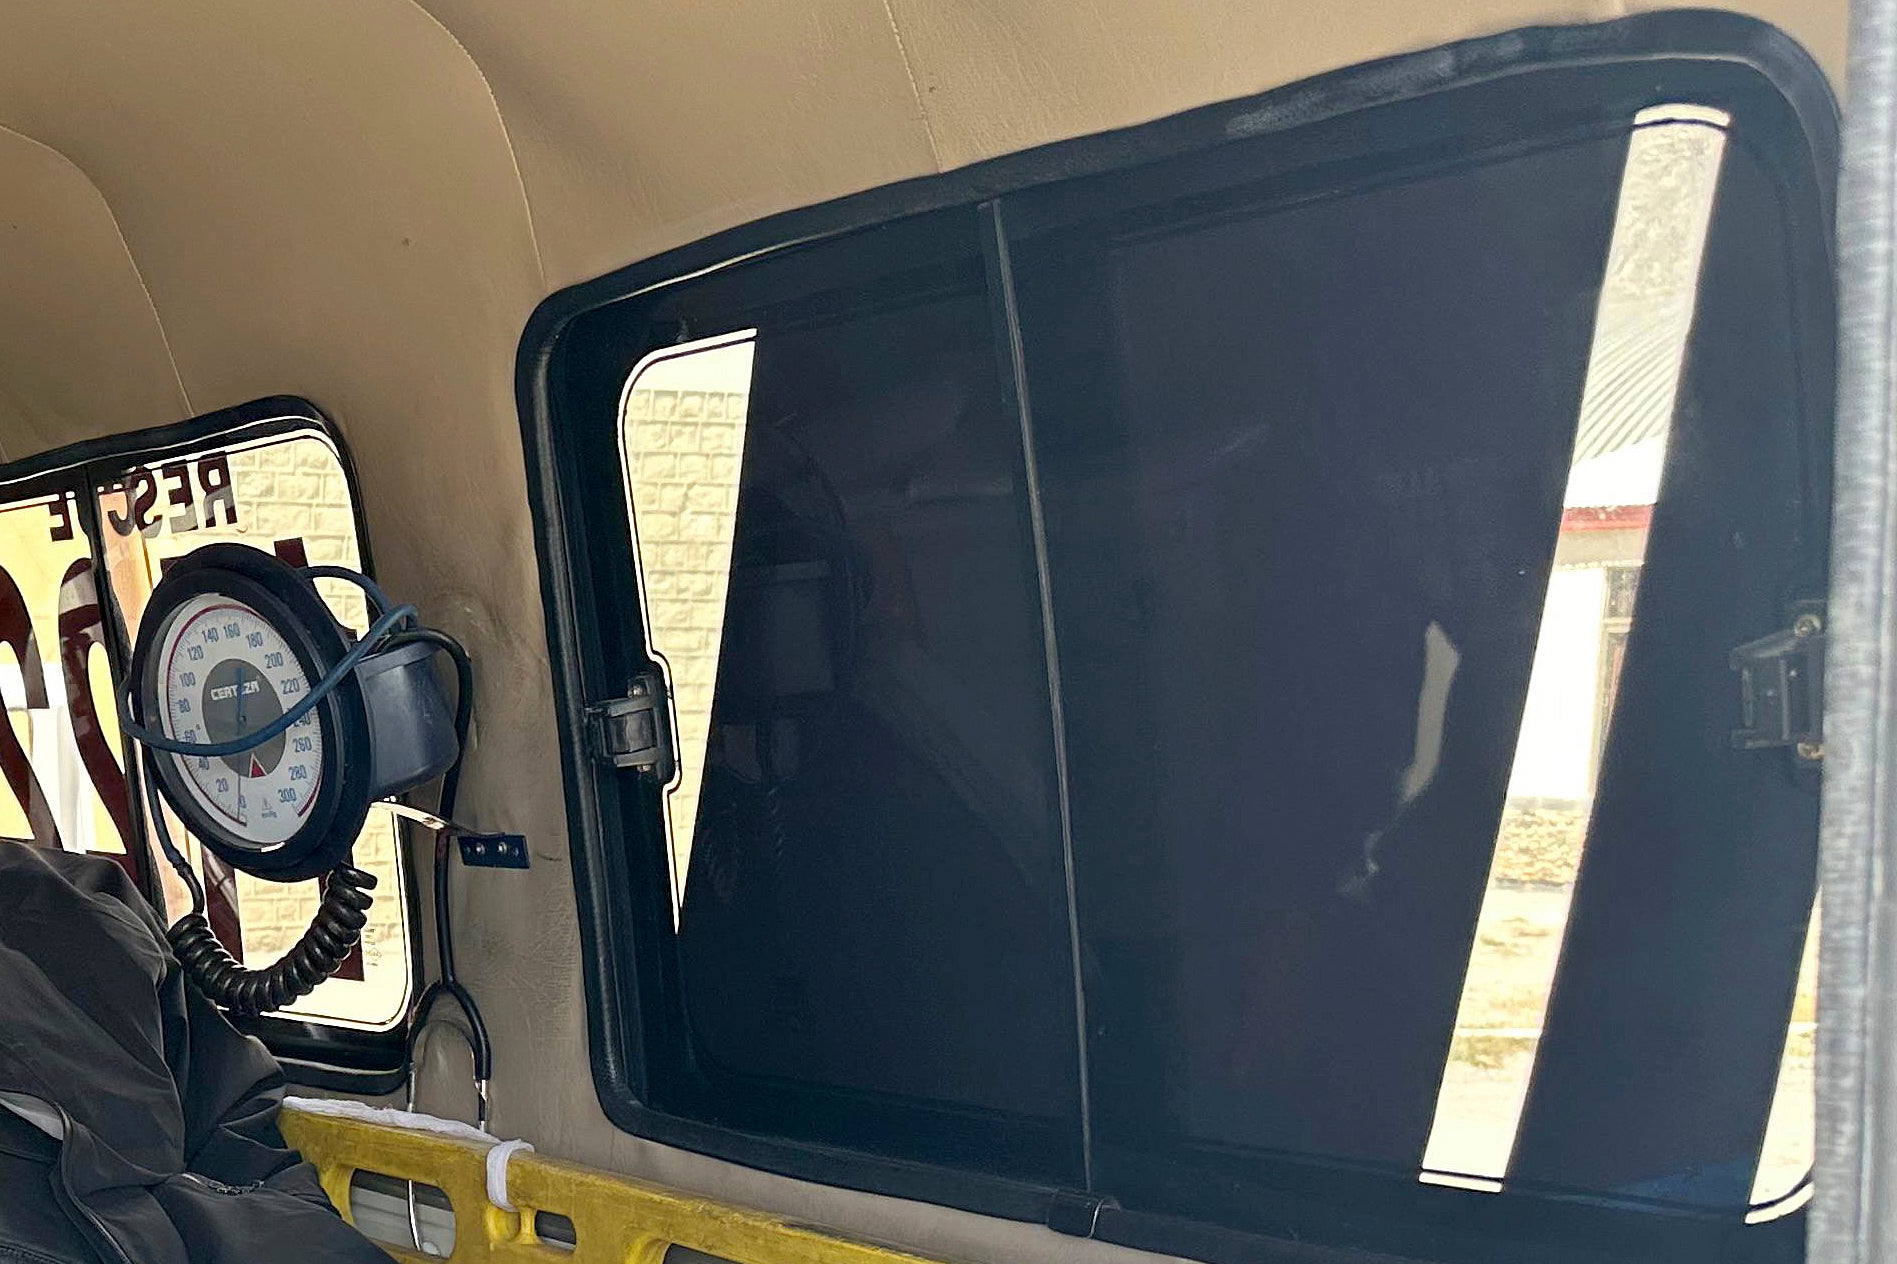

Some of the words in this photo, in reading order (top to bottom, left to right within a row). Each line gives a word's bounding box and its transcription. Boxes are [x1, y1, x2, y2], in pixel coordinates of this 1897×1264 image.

[202, 627, 219, 644] 140
[223, 622, 240, 639] 160
[246, 632, 264, 649] 180
[187, 644, 204, 661] 120
[265, 652, 284, 669] 200
[179, 672, 196, 687] 100
[281, 678, 300, 695] 220
[178, 698, 191, 714] 80
[293, 736, 312, 753] 260
[288, 764, 307, 781] 280
[216, 777, 229, 792] 20
[277, 787, 297, 803] 300
